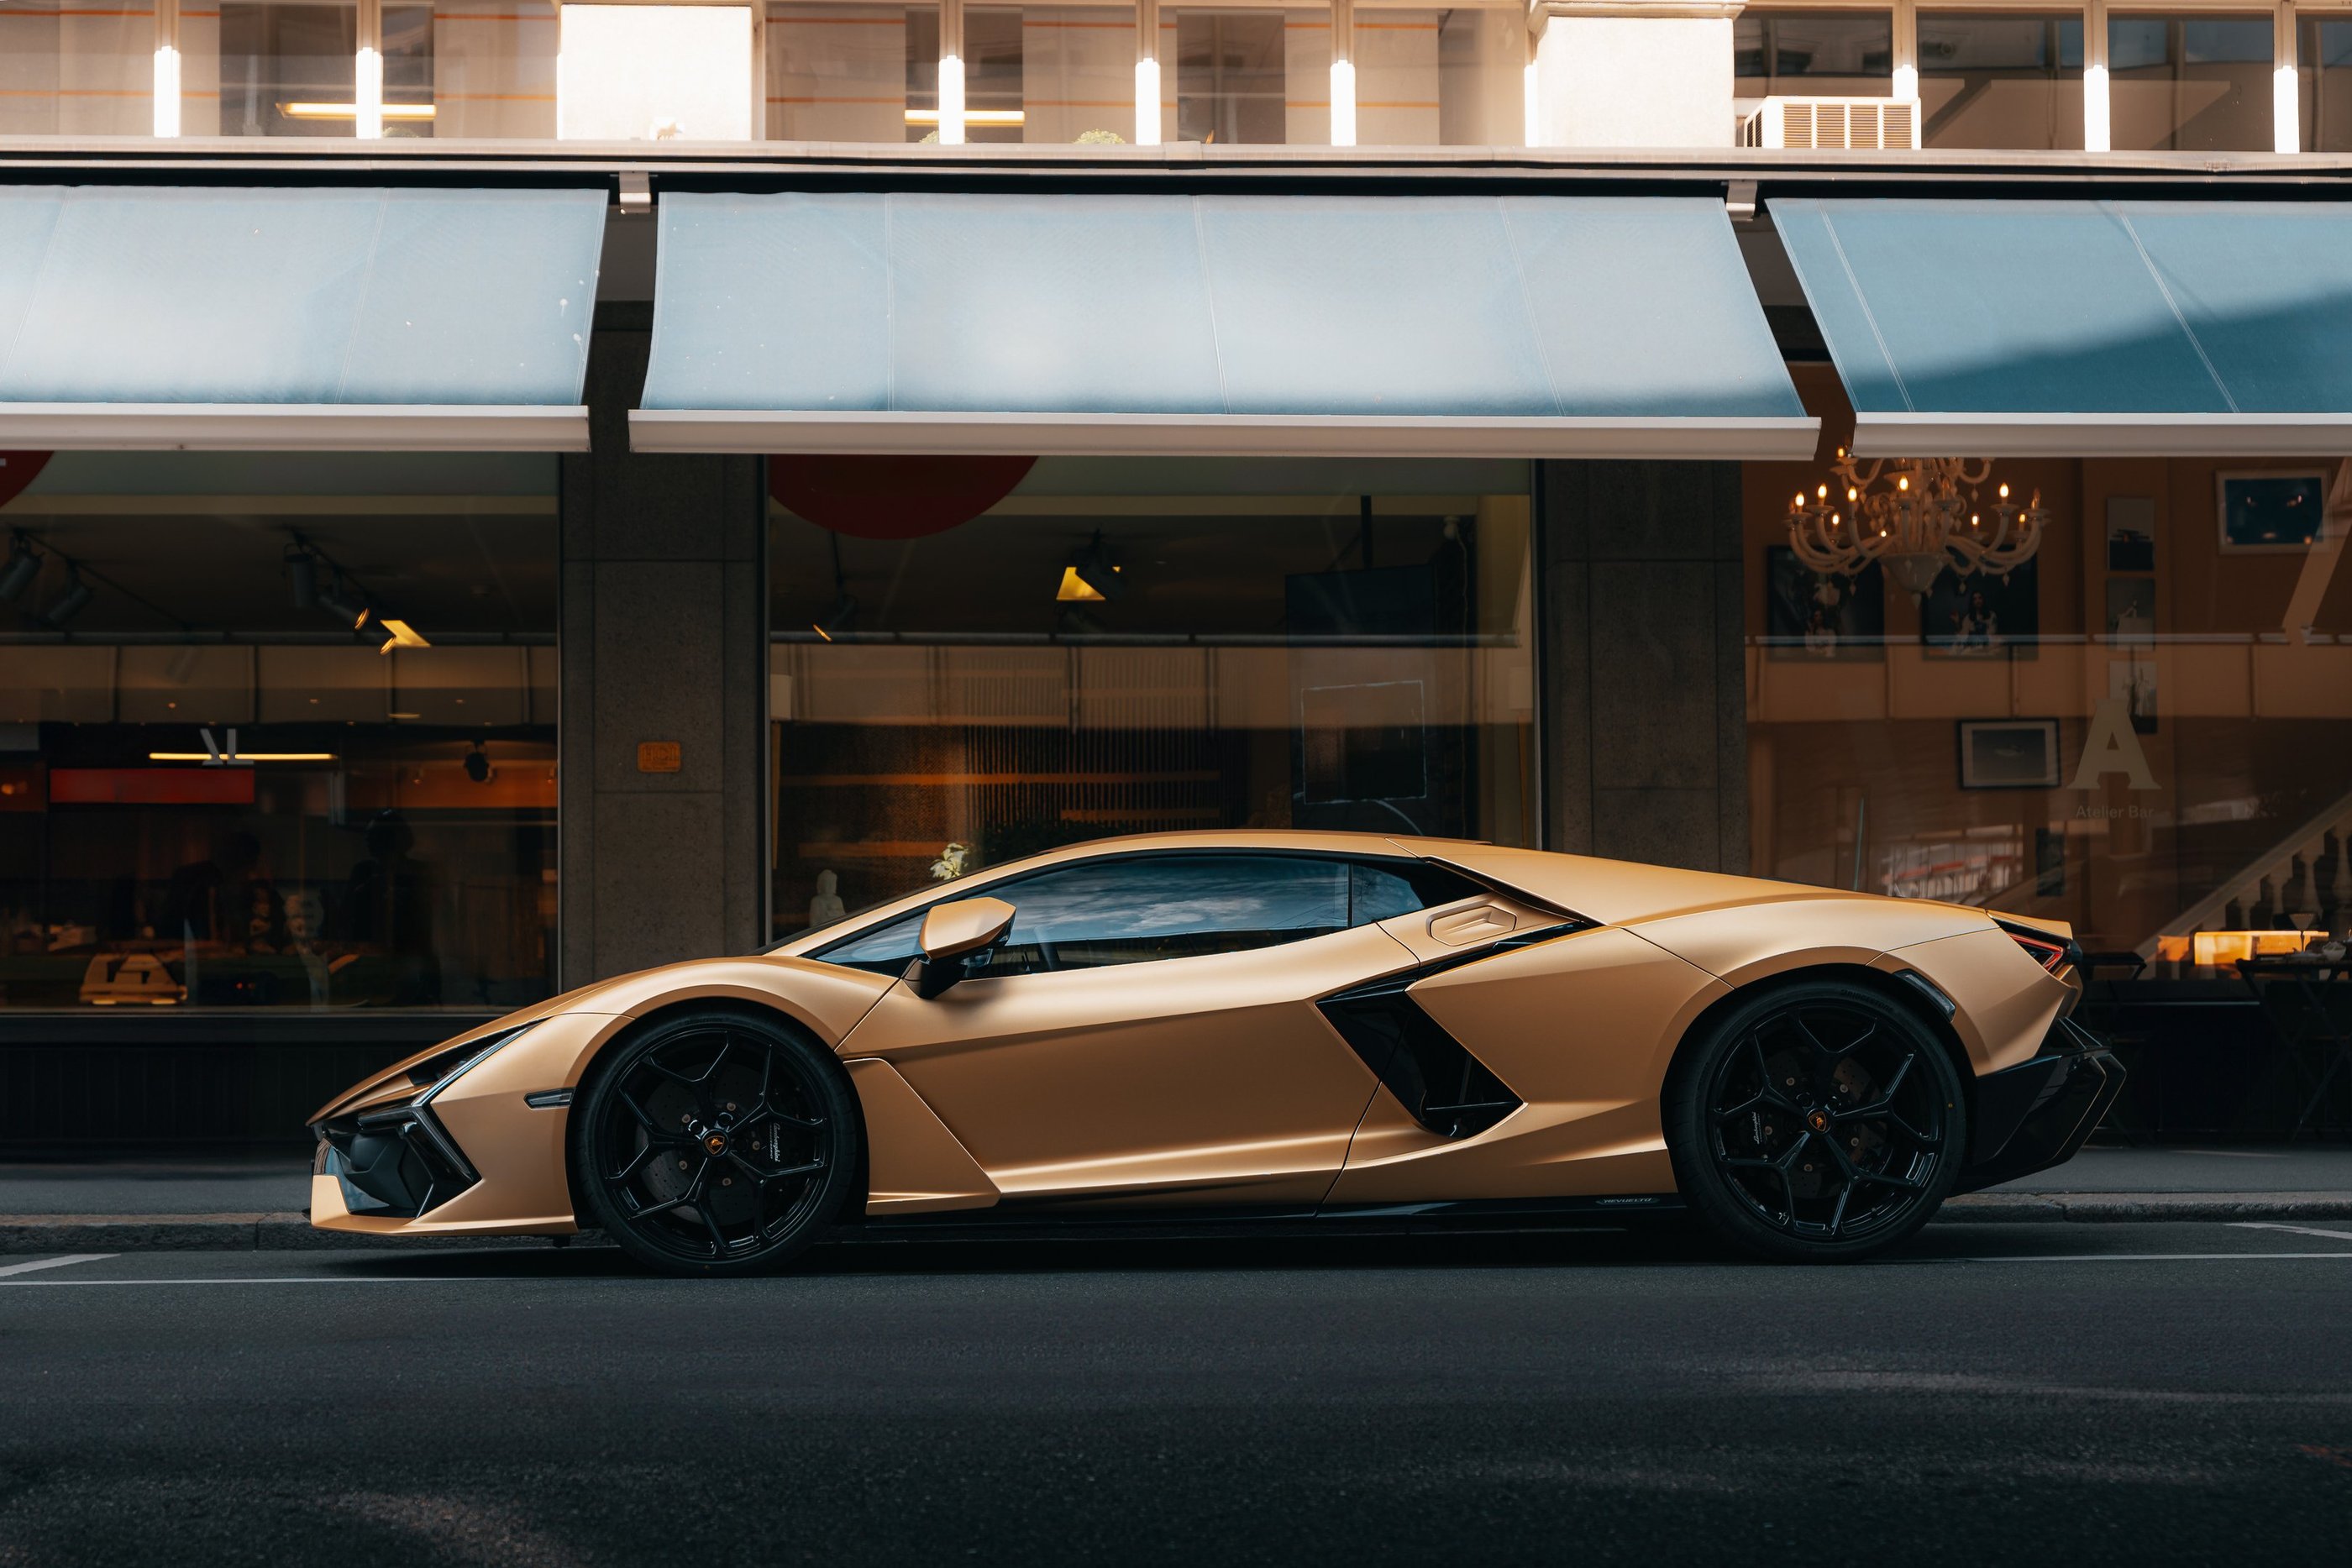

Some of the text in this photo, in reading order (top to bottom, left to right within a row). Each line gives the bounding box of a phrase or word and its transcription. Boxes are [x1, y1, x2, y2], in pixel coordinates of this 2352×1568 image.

[2066, 699, 2163, 789] A
[2076, 805, 2155, 819] Atelier Bar
